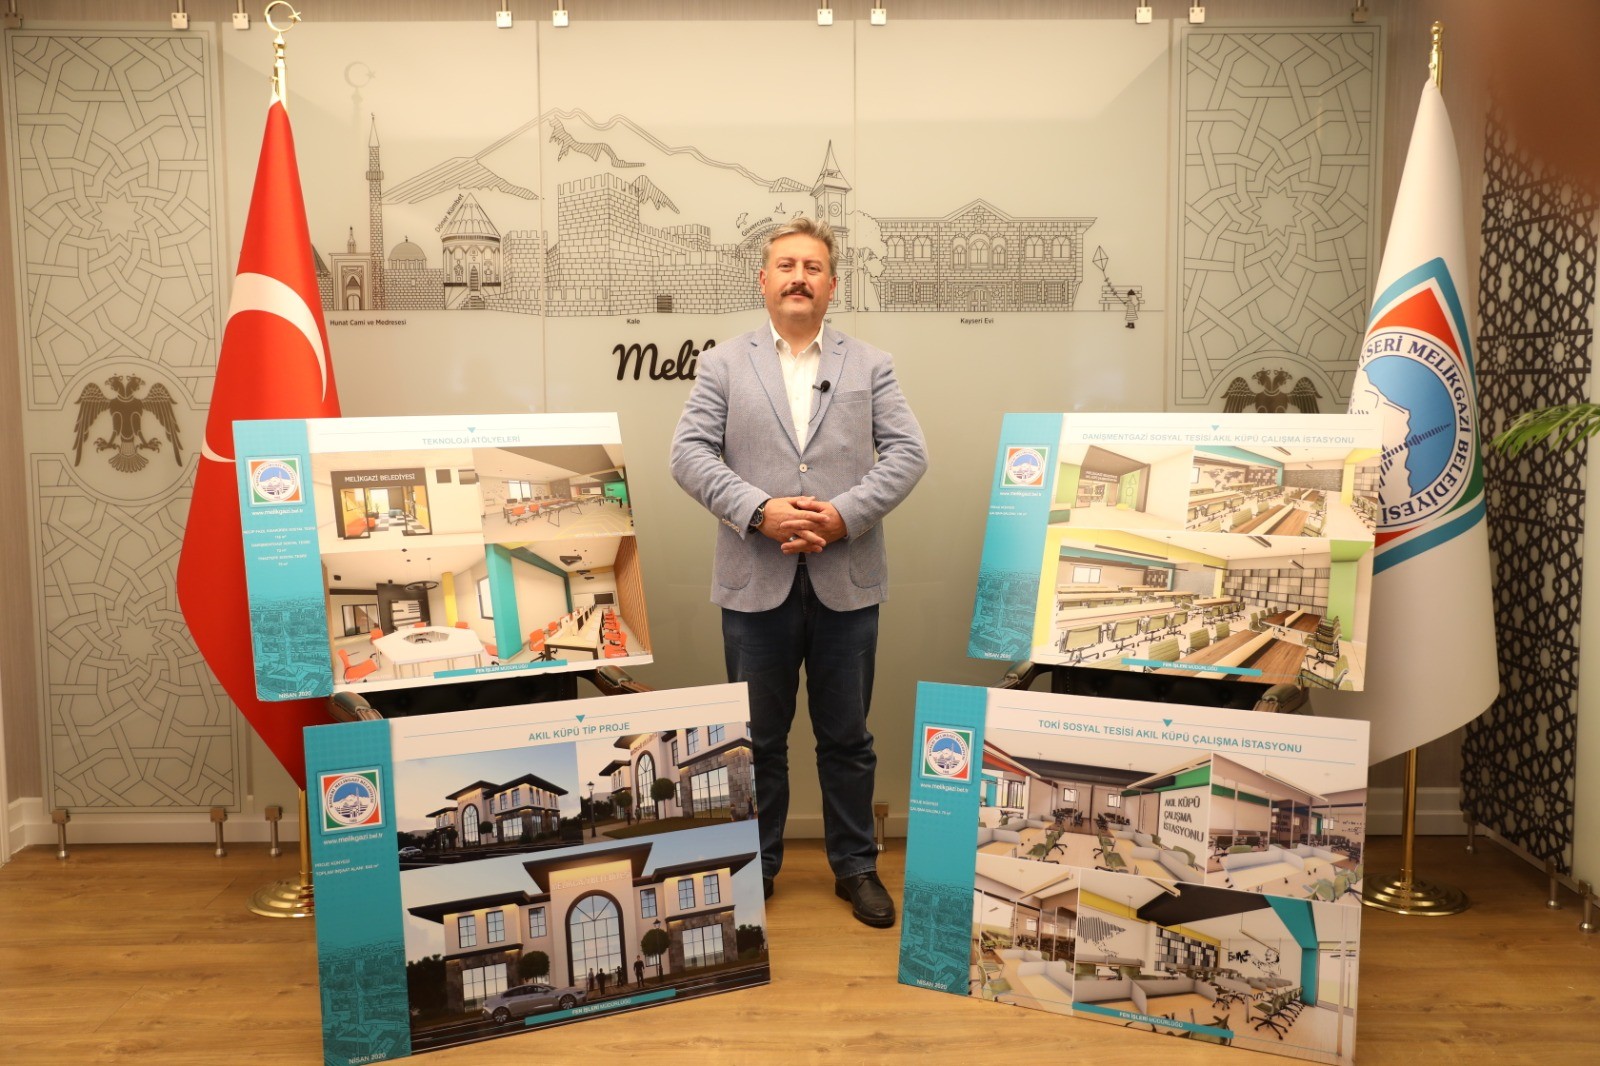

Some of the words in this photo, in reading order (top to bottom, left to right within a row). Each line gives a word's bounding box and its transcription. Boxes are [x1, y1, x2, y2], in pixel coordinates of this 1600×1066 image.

[446, 193, 464, 216] Kümbet
[1408, 341, 1471, 434] MELİKGAZİ
[422, 436, 470, 446] TEKNOLOJİ
[471, 434, 520, 444] ATÖLYELERİ
[1150, 434, 1182, 442] SOSYAL
[1184, 434, 1212, 442] TESİSİ
[1234, 434, 1259, 442] KÜPÜ
[1261, 435, 1301, 444] ÇALIŞMA
[1303, 435, 1355, 444] İSTASYONU
[1382, 439, 1469, 524] BELEDİYESİ
[528, 732, 551, 741] AKIL
[553, 726, 580, 738] KÜPÜ
[582, 724, 597, 734] TİP
[599, 722, 630, 734] PROJE
[1038, 720, 1060, 730] TOKİ
[1062, 722, 1100, 734] SOSYAL
[1103, 725, 1134, 736] TESİSİ
[1136, 729, 1158, 740] AKIL
[1162, 730, 1190, 742] KÜPÜ
[1192, 734, 1238, 747] ÇALIŞMA
[1241, 738, 1302, 753] İSTASYONU
[1178, 796, 1200, 808] KÜPÜ
[1164, 810, 1192, 823] ÇALIŞMA
[1163, 821, 1204, 842] İSTASYONU
[371, 1052, 387, 1060] 2020
